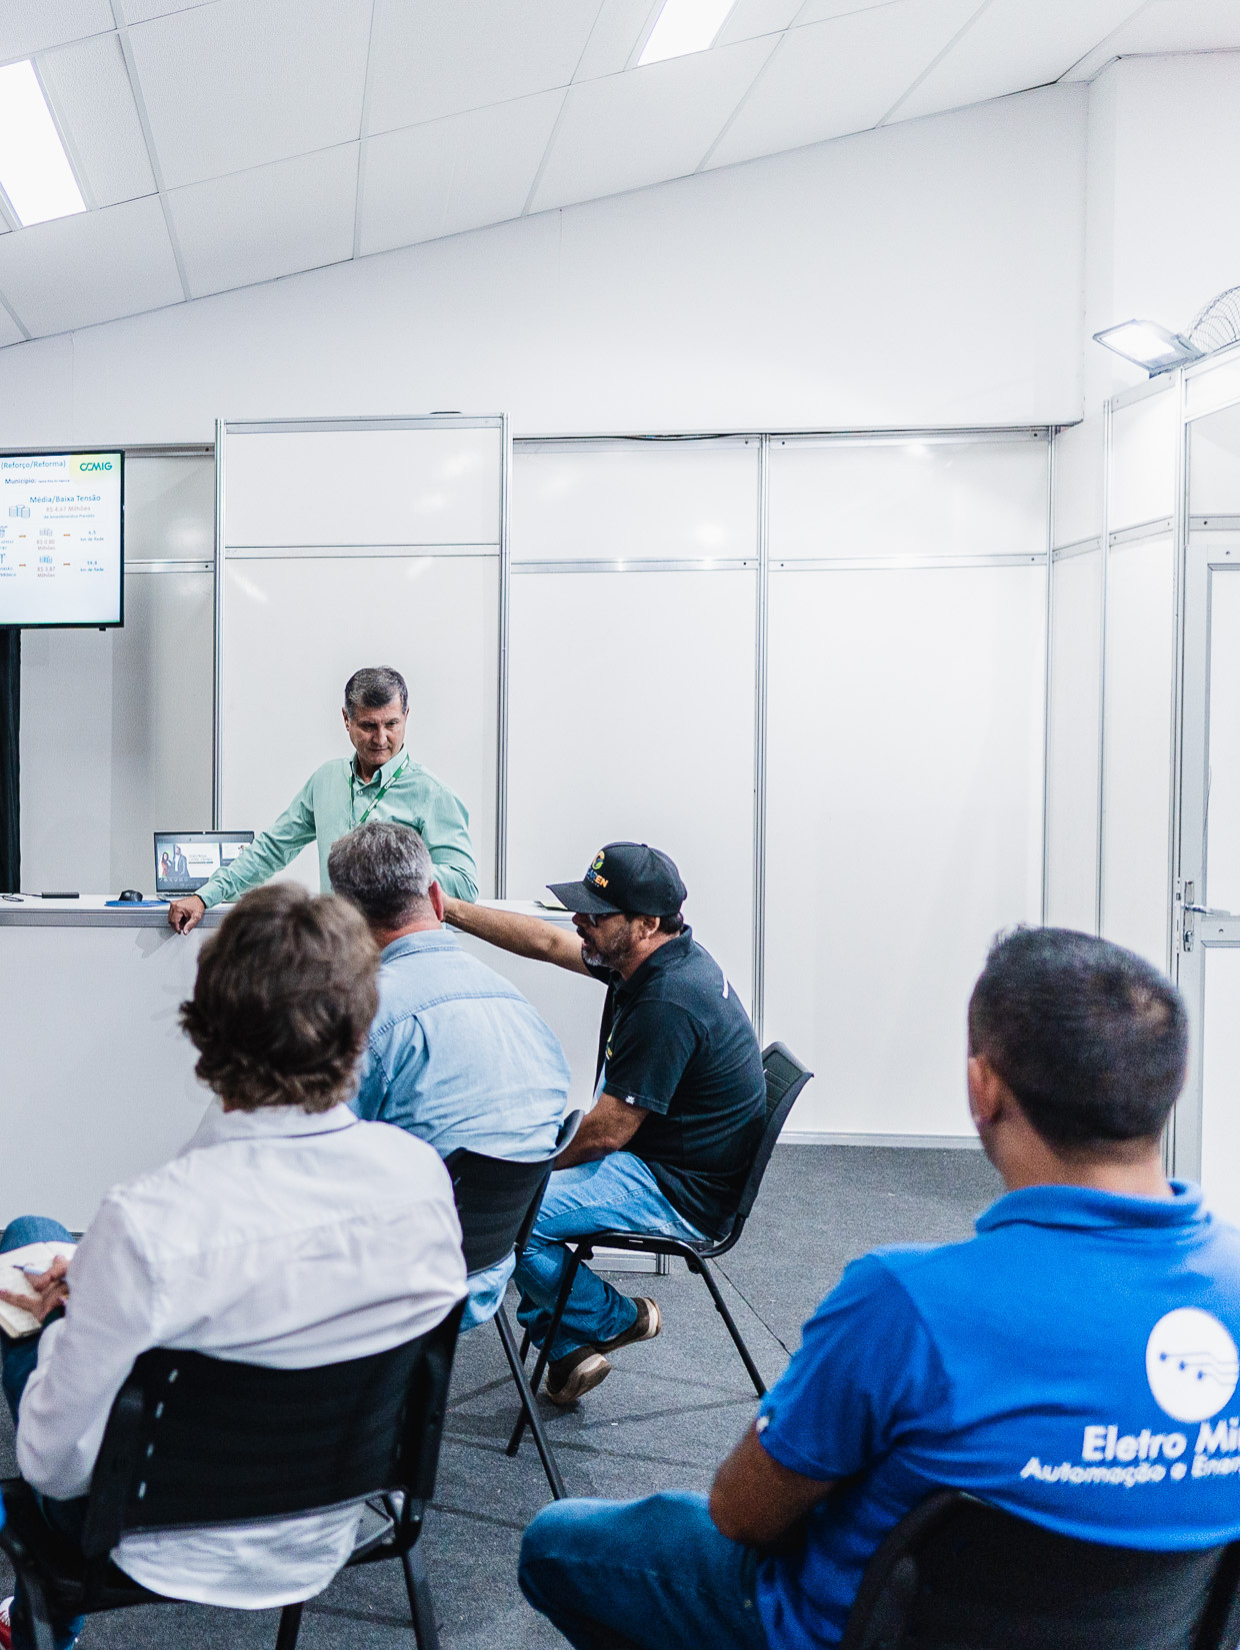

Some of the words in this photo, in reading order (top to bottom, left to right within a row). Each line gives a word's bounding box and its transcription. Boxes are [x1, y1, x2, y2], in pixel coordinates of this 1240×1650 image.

[30, 495, 74, 503] Média/Baixa
[1081, 1424, 1187, 1462] Eletro
[1194, 1416, 1240, 1454] Mi
[1020, 1456, 1166, 1488] Automação
[1170, 1462, 1187, 1480] e
